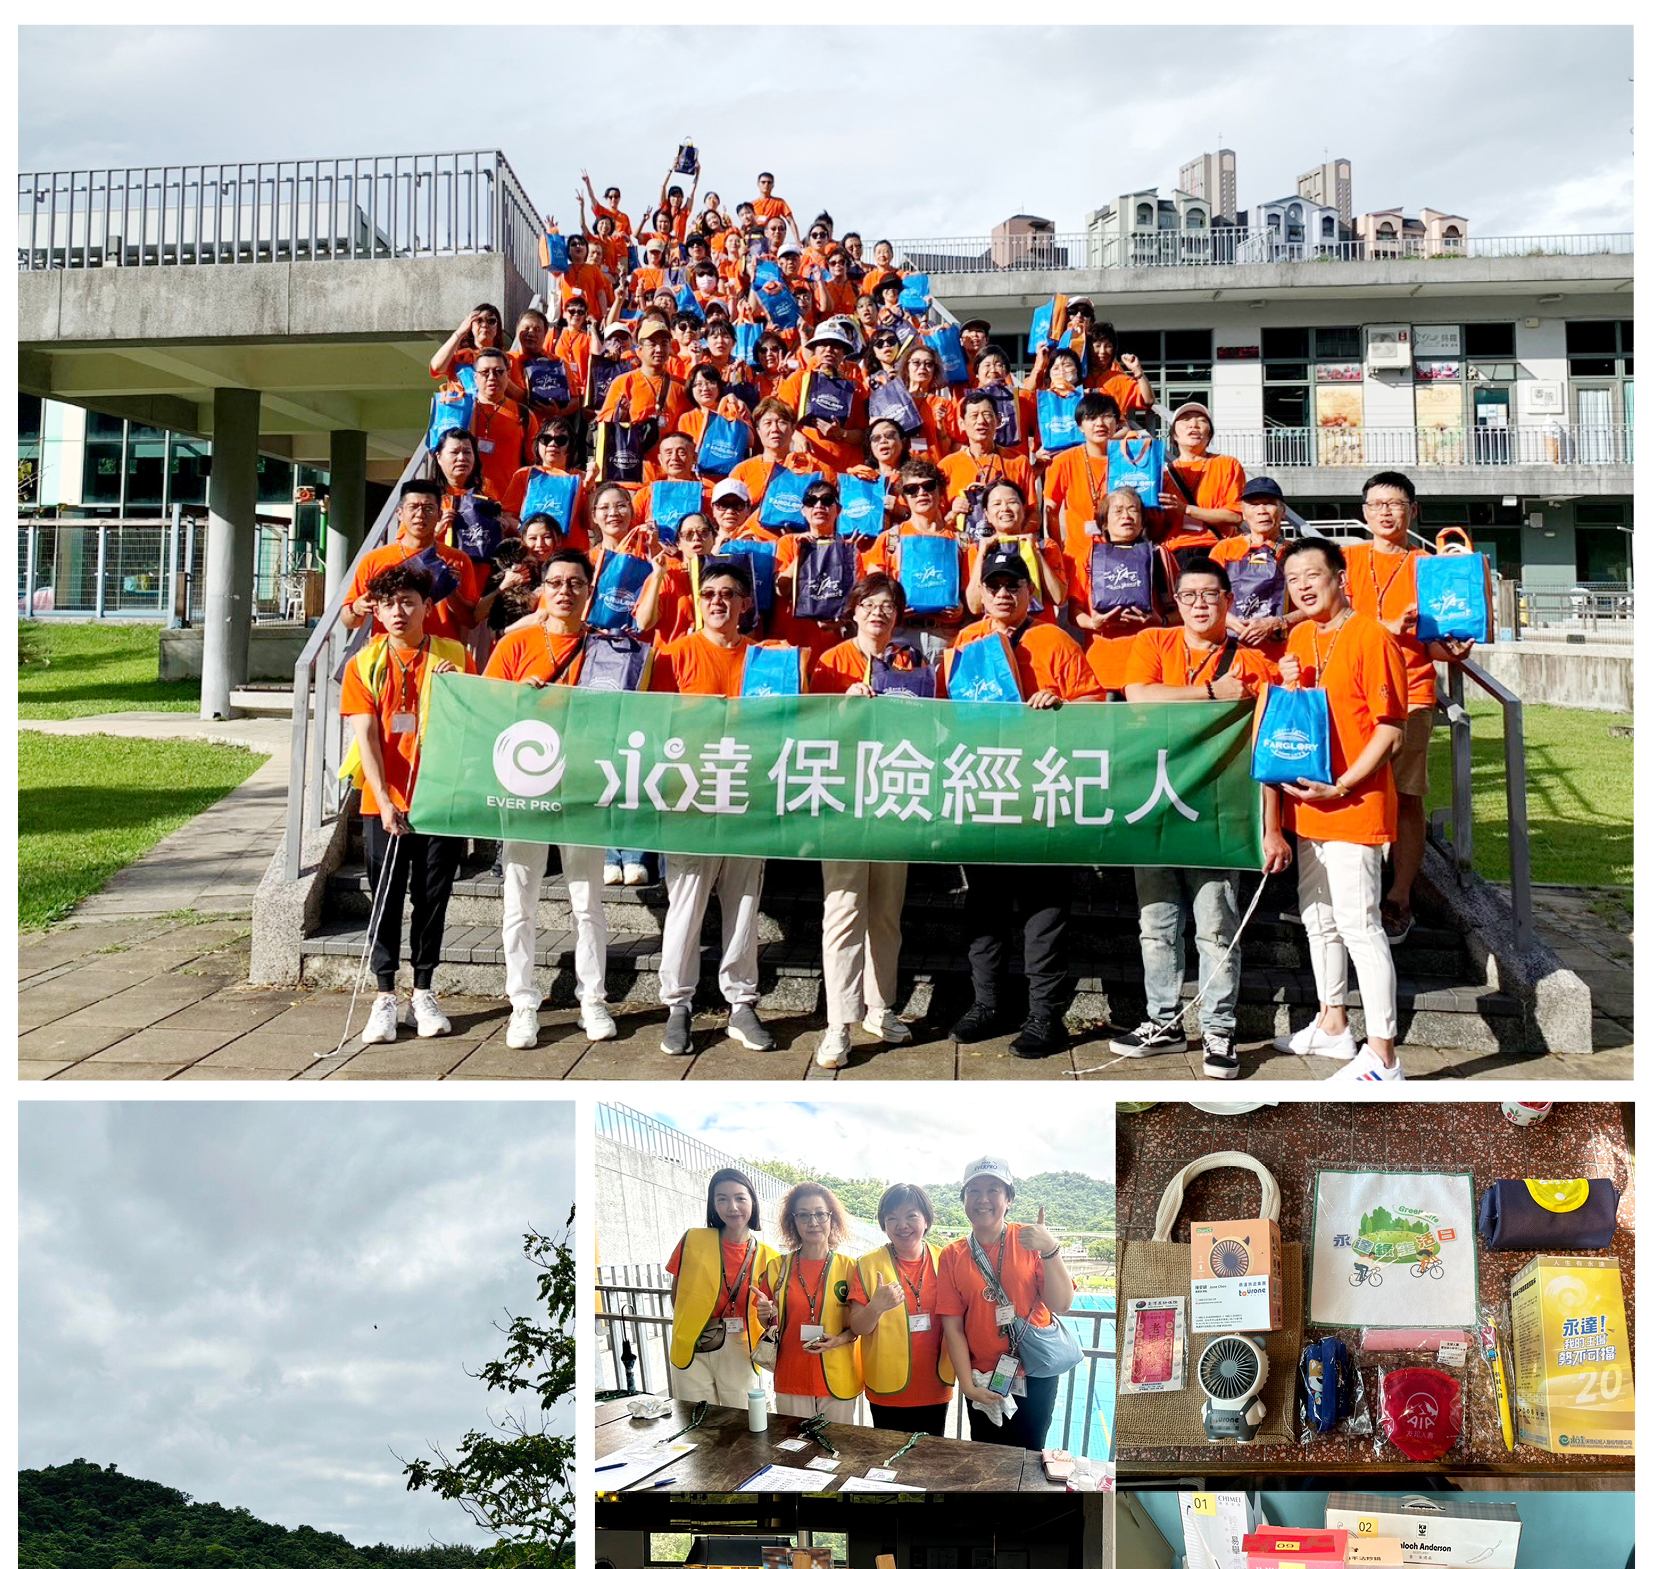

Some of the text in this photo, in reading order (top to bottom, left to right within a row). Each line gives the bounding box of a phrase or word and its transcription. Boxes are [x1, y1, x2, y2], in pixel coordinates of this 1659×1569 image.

[1263, 738, 1319, 752] FARGLORY
[486, 795, 563, 813] EVER PRO
[1398, 1205, 1423, 1215] Green
[1553, 1260, 1606, 1268] 人生有永達
[1575, 1363, 1623, 1405] 20
[1406, 1416, 1436, 1430] AIA
[1194, 1497, 1207, 1510] 01
[1358, 1521, 1372, 1533] 02
[1419, 1542, 1452, 1552] Anderson
